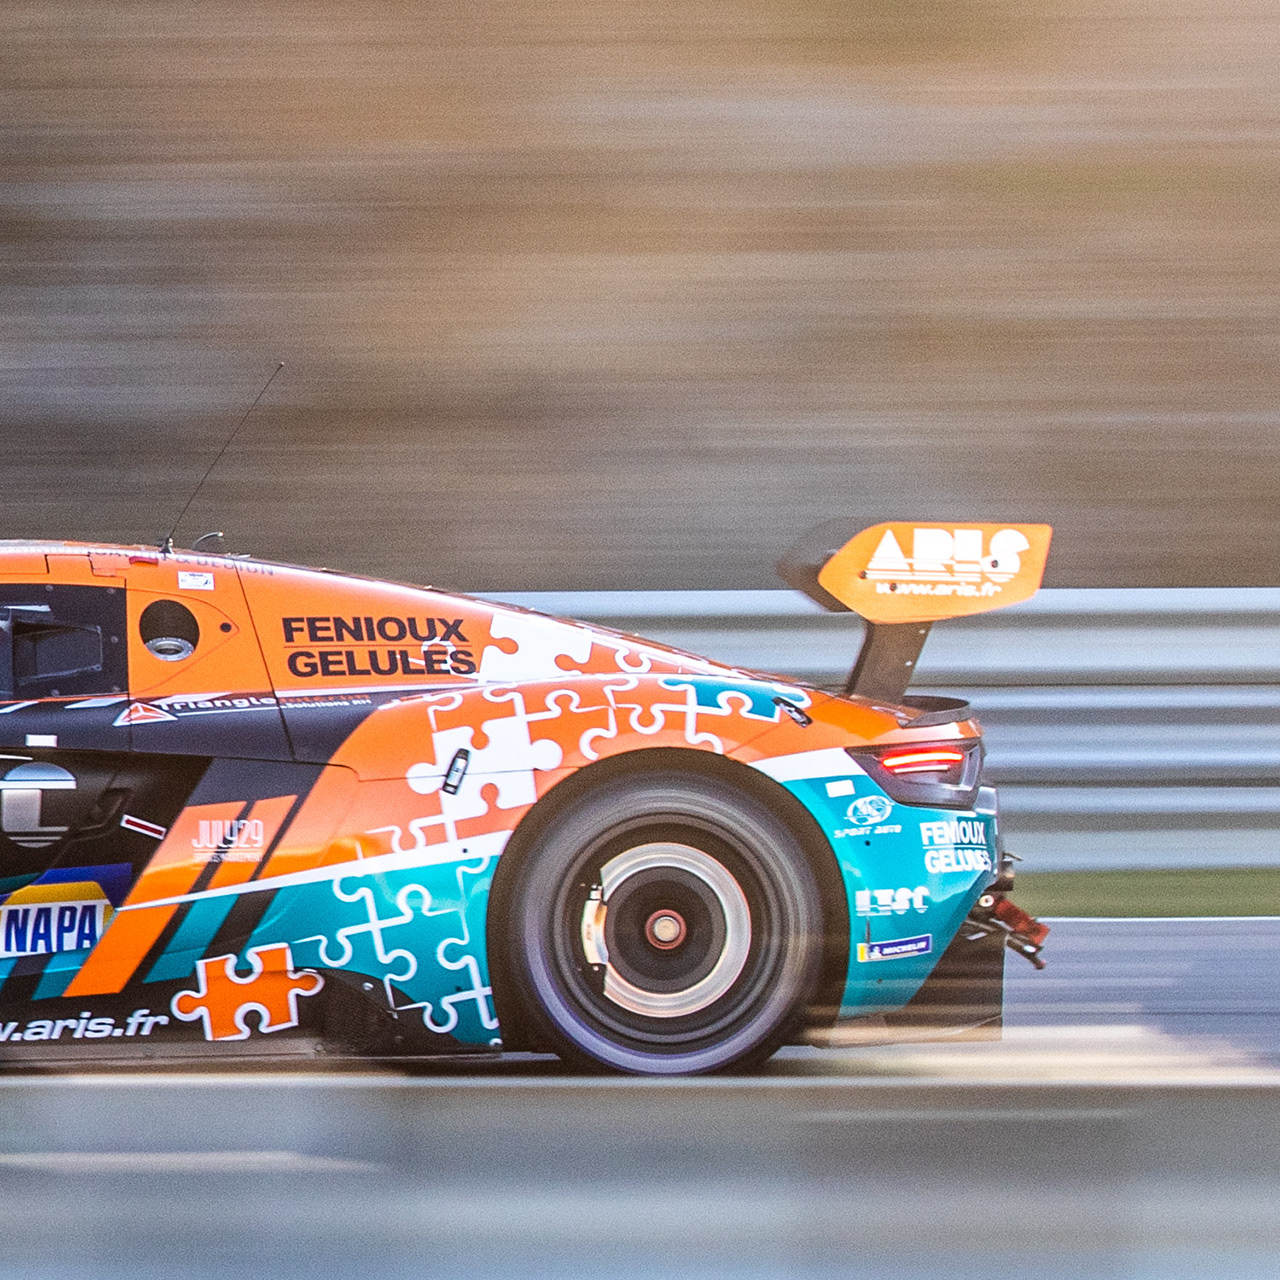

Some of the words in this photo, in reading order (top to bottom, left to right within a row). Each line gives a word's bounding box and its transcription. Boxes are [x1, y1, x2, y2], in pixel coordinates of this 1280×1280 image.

[864, 527, 1031, 584] ARIS
[282, 616, 470, 643] FENIOUX
[287, 650, 477, 678] GELULES
[919, 820, 987, 846] FENIOUX
[4, 904, 99, 953] NAPA
